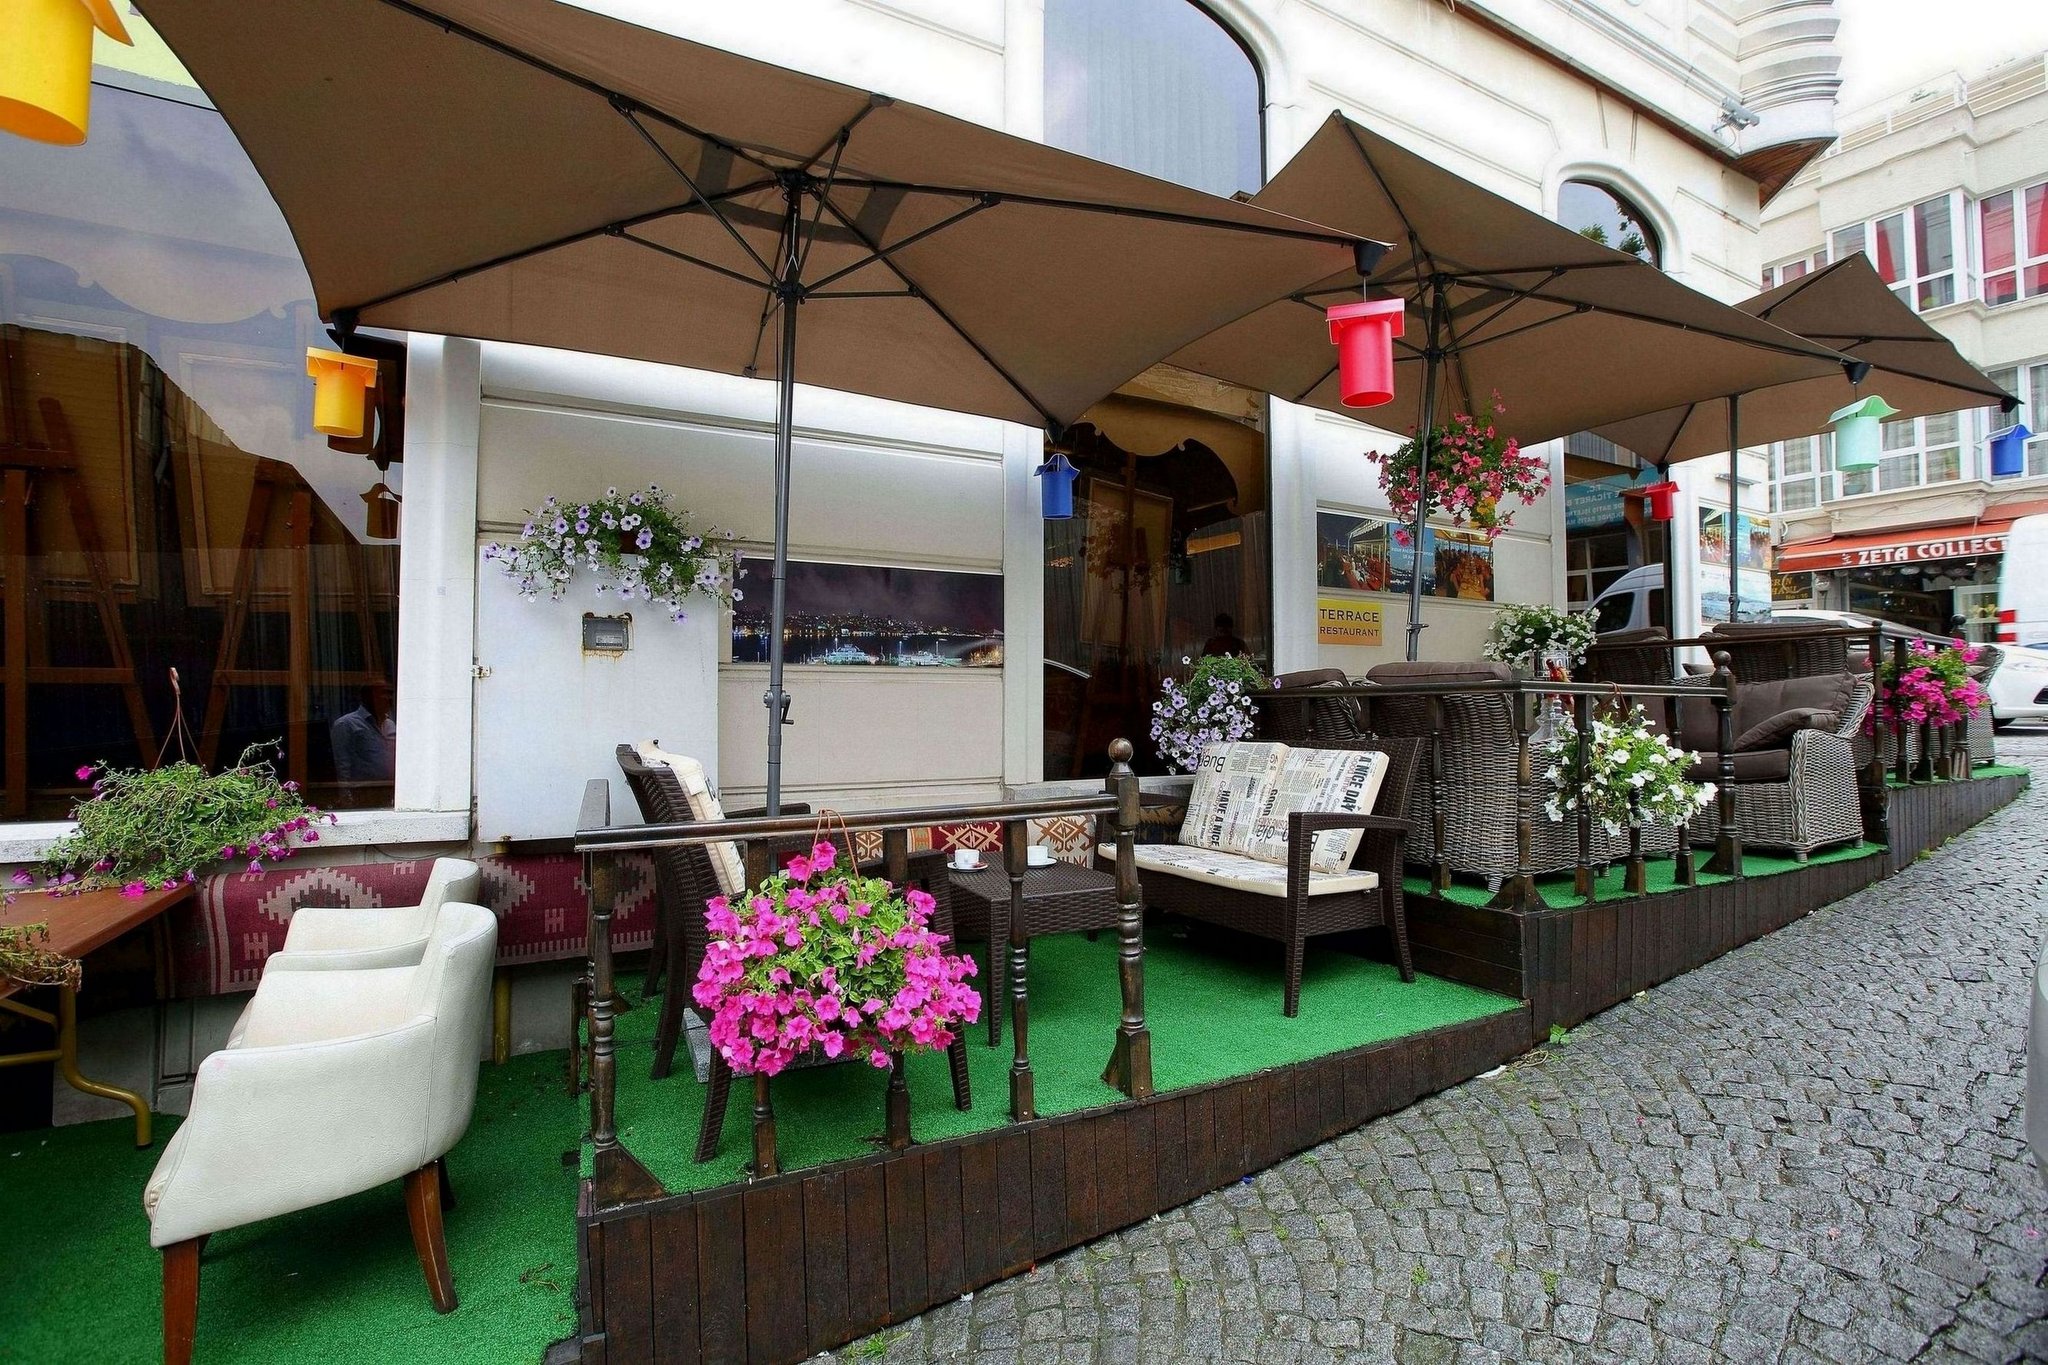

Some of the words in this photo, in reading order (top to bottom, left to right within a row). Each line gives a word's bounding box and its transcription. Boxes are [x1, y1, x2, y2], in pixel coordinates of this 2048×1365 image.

[1858, 547, 1909, 566] ZETA
[1319, 608, 1380, 623] TERRACE
[1319, 626, 1380, 637] RESTAURANT
[1349, 764, 1370, 789] NICE
[1216, 790, 1231, 815] HAVE
[1341, 789, 1360, 812] DAY
[1211, 824, 1223, 847] NICE
